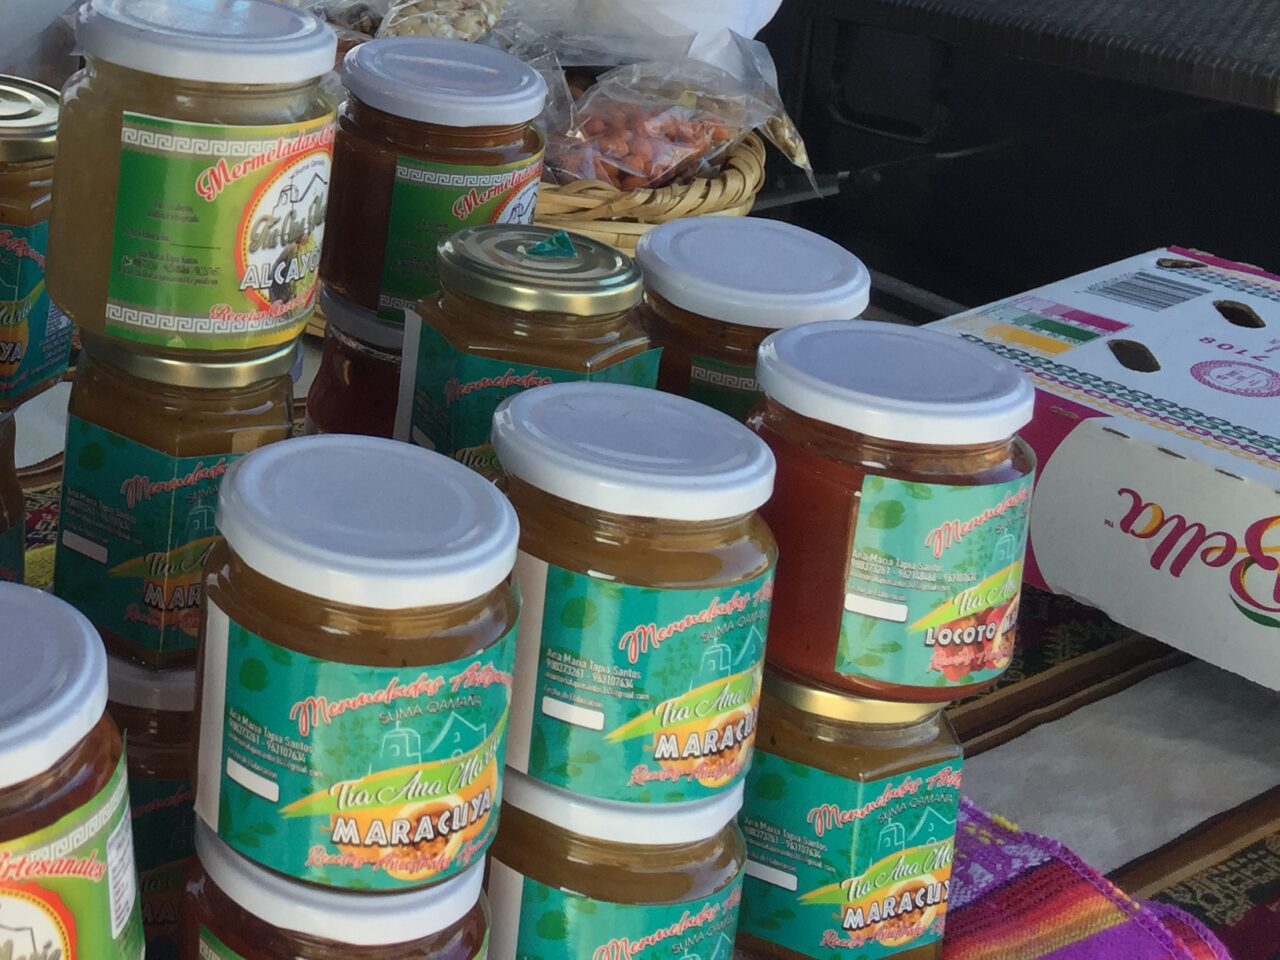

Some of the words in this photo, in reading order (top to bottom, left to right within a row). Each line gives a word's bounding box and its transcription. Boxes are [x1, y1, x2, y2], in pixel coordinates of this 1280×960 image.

[195, 129, 320, 202] Mermeladas
[618, 590, 750, 664] Mermeladas
[924, 622, 997, 647] LOCOTO
[547, 648, 561, 662] Ana
[613, 665, 642, 679] Santos
[289, 672, 446, 737] Mermeladas
[378, 705, 423, 725] SUMA
[285, 736, 313, 753] Santos
[378, 769, 441, 804] Ana
[330, 786, 492, 848] MARACUYA
[807, 776, 923, 837] Mermeladas
[877, 802, 907, 824] SUMA
[874, 855, 919, 889] Ana
